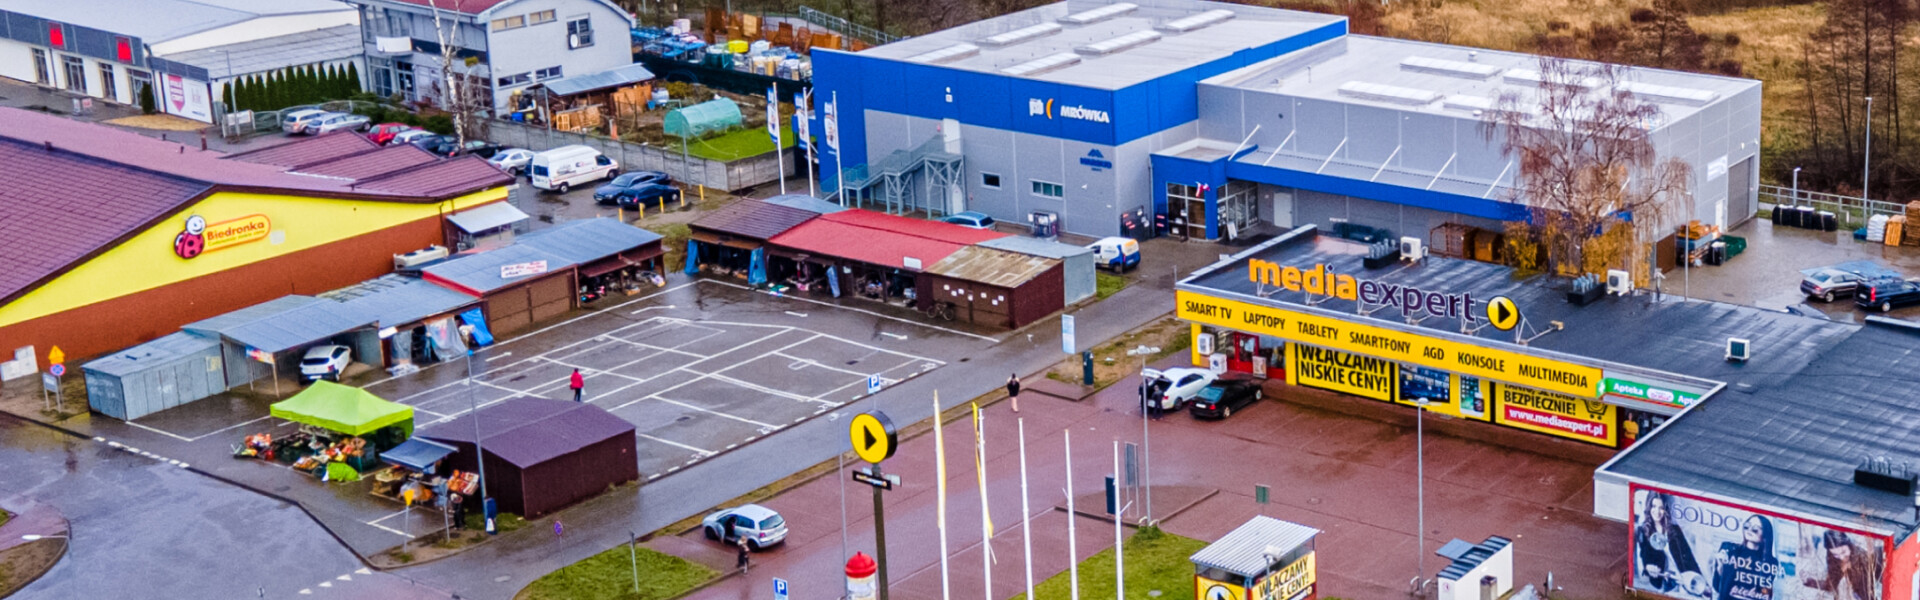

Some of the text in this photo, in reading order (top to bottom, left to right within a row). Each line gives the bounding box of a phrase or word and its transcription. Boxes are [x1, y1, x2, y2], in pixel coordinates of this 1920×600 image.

[1060, 104, 1110, 123] MRÓWKA
[207, 221, 264, 241] Biedronka
[1248, 257, 1476, 323] mediaexpert
[1185, 300, 1588, 389] SMART TV LAPTOPY TABLETY SMARTFONY AGD KONSOLE MULTIMEDIA
[1301, 360, 1388, 393] NISKIE CENY!
[1613, 382, 1644, 396] Apteka
[1504, 390, 1576, 416] BEZPIECZNIE!
[1509, 409, 1604, 436] www.mediaexpert.pl
[1672, 503, 1740, 532] SOLDO
[777, 581, 785, 593] P
[1734, 571, 1773, 590] JESTEŚ
